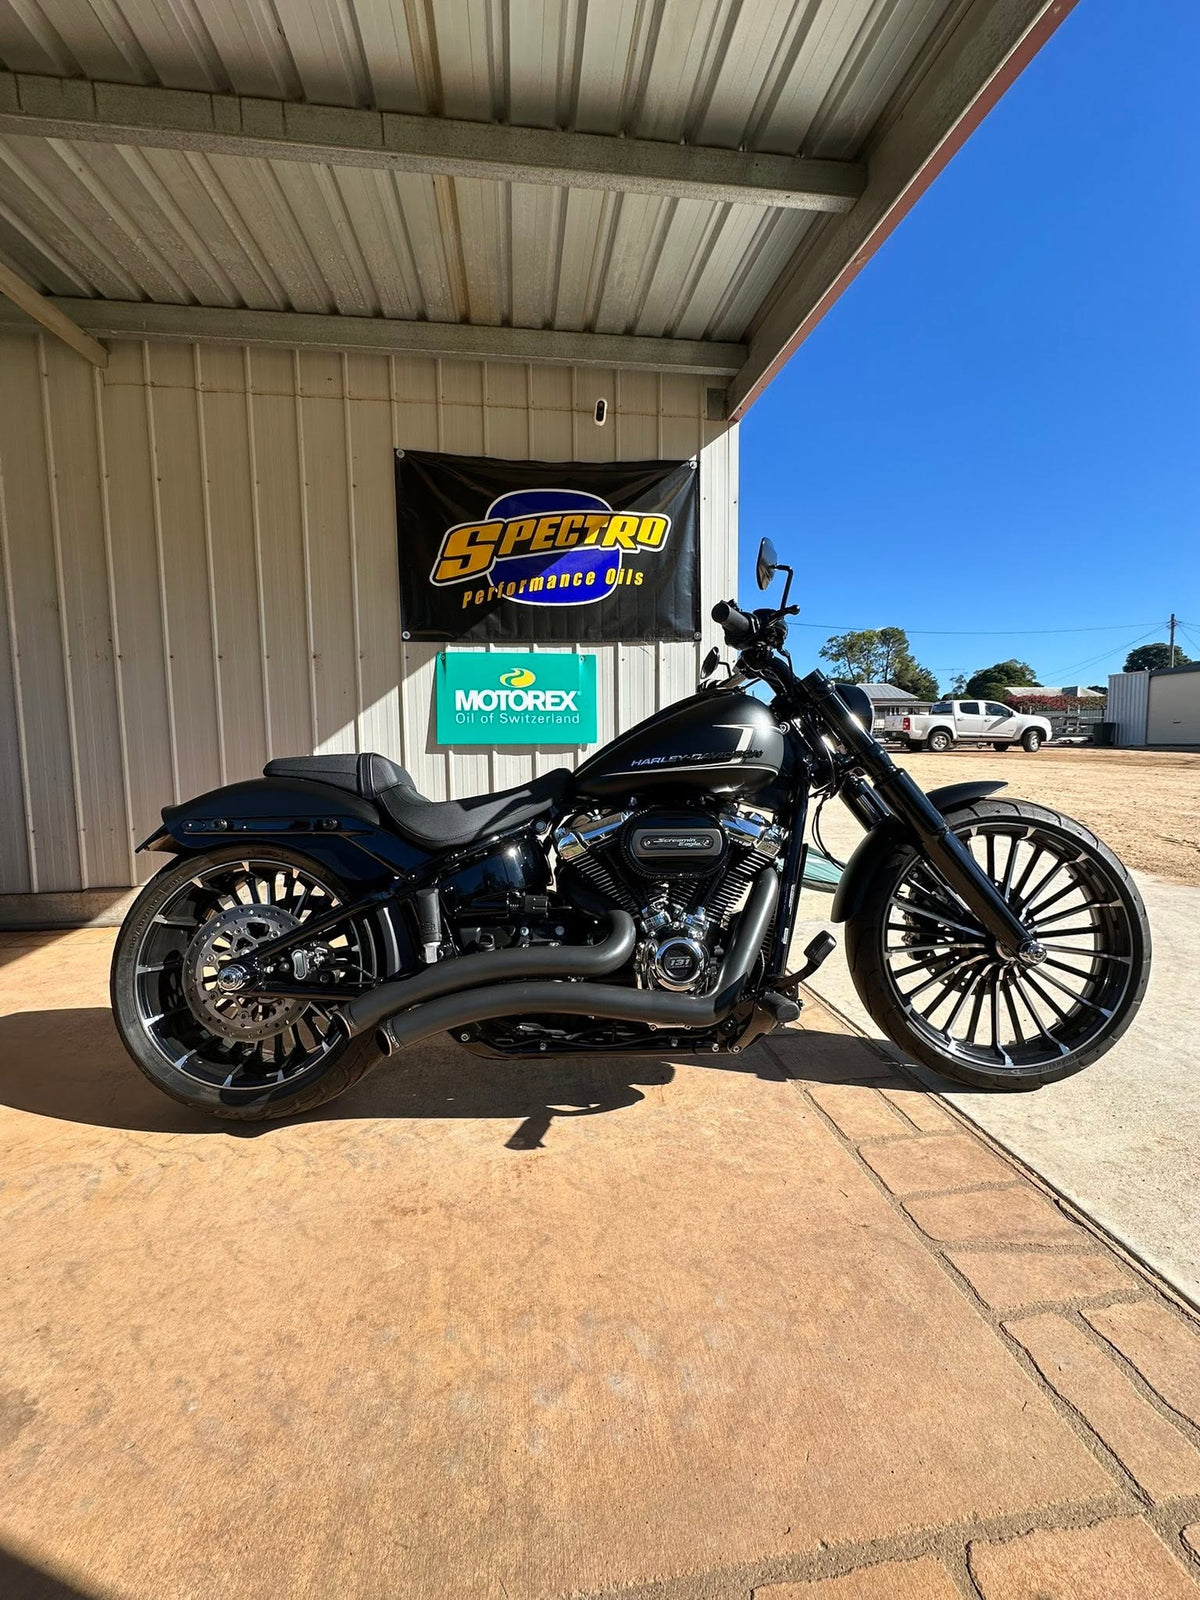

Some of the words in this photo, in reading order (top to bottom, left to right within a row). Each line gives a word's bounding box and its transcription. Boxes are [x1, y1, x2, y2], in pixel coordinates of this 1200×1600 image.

[432, 512, 670, 584] SPECTRO
[462, 571, 596, 609] Performance
[605, 567, 644, 586] Oils
[455, 689, 579, 712] MOTOREX
[455, 712, 475, 724] Oil
[480, 712, 495, 724] of
[499, 712, 580, 724] Switzerland
